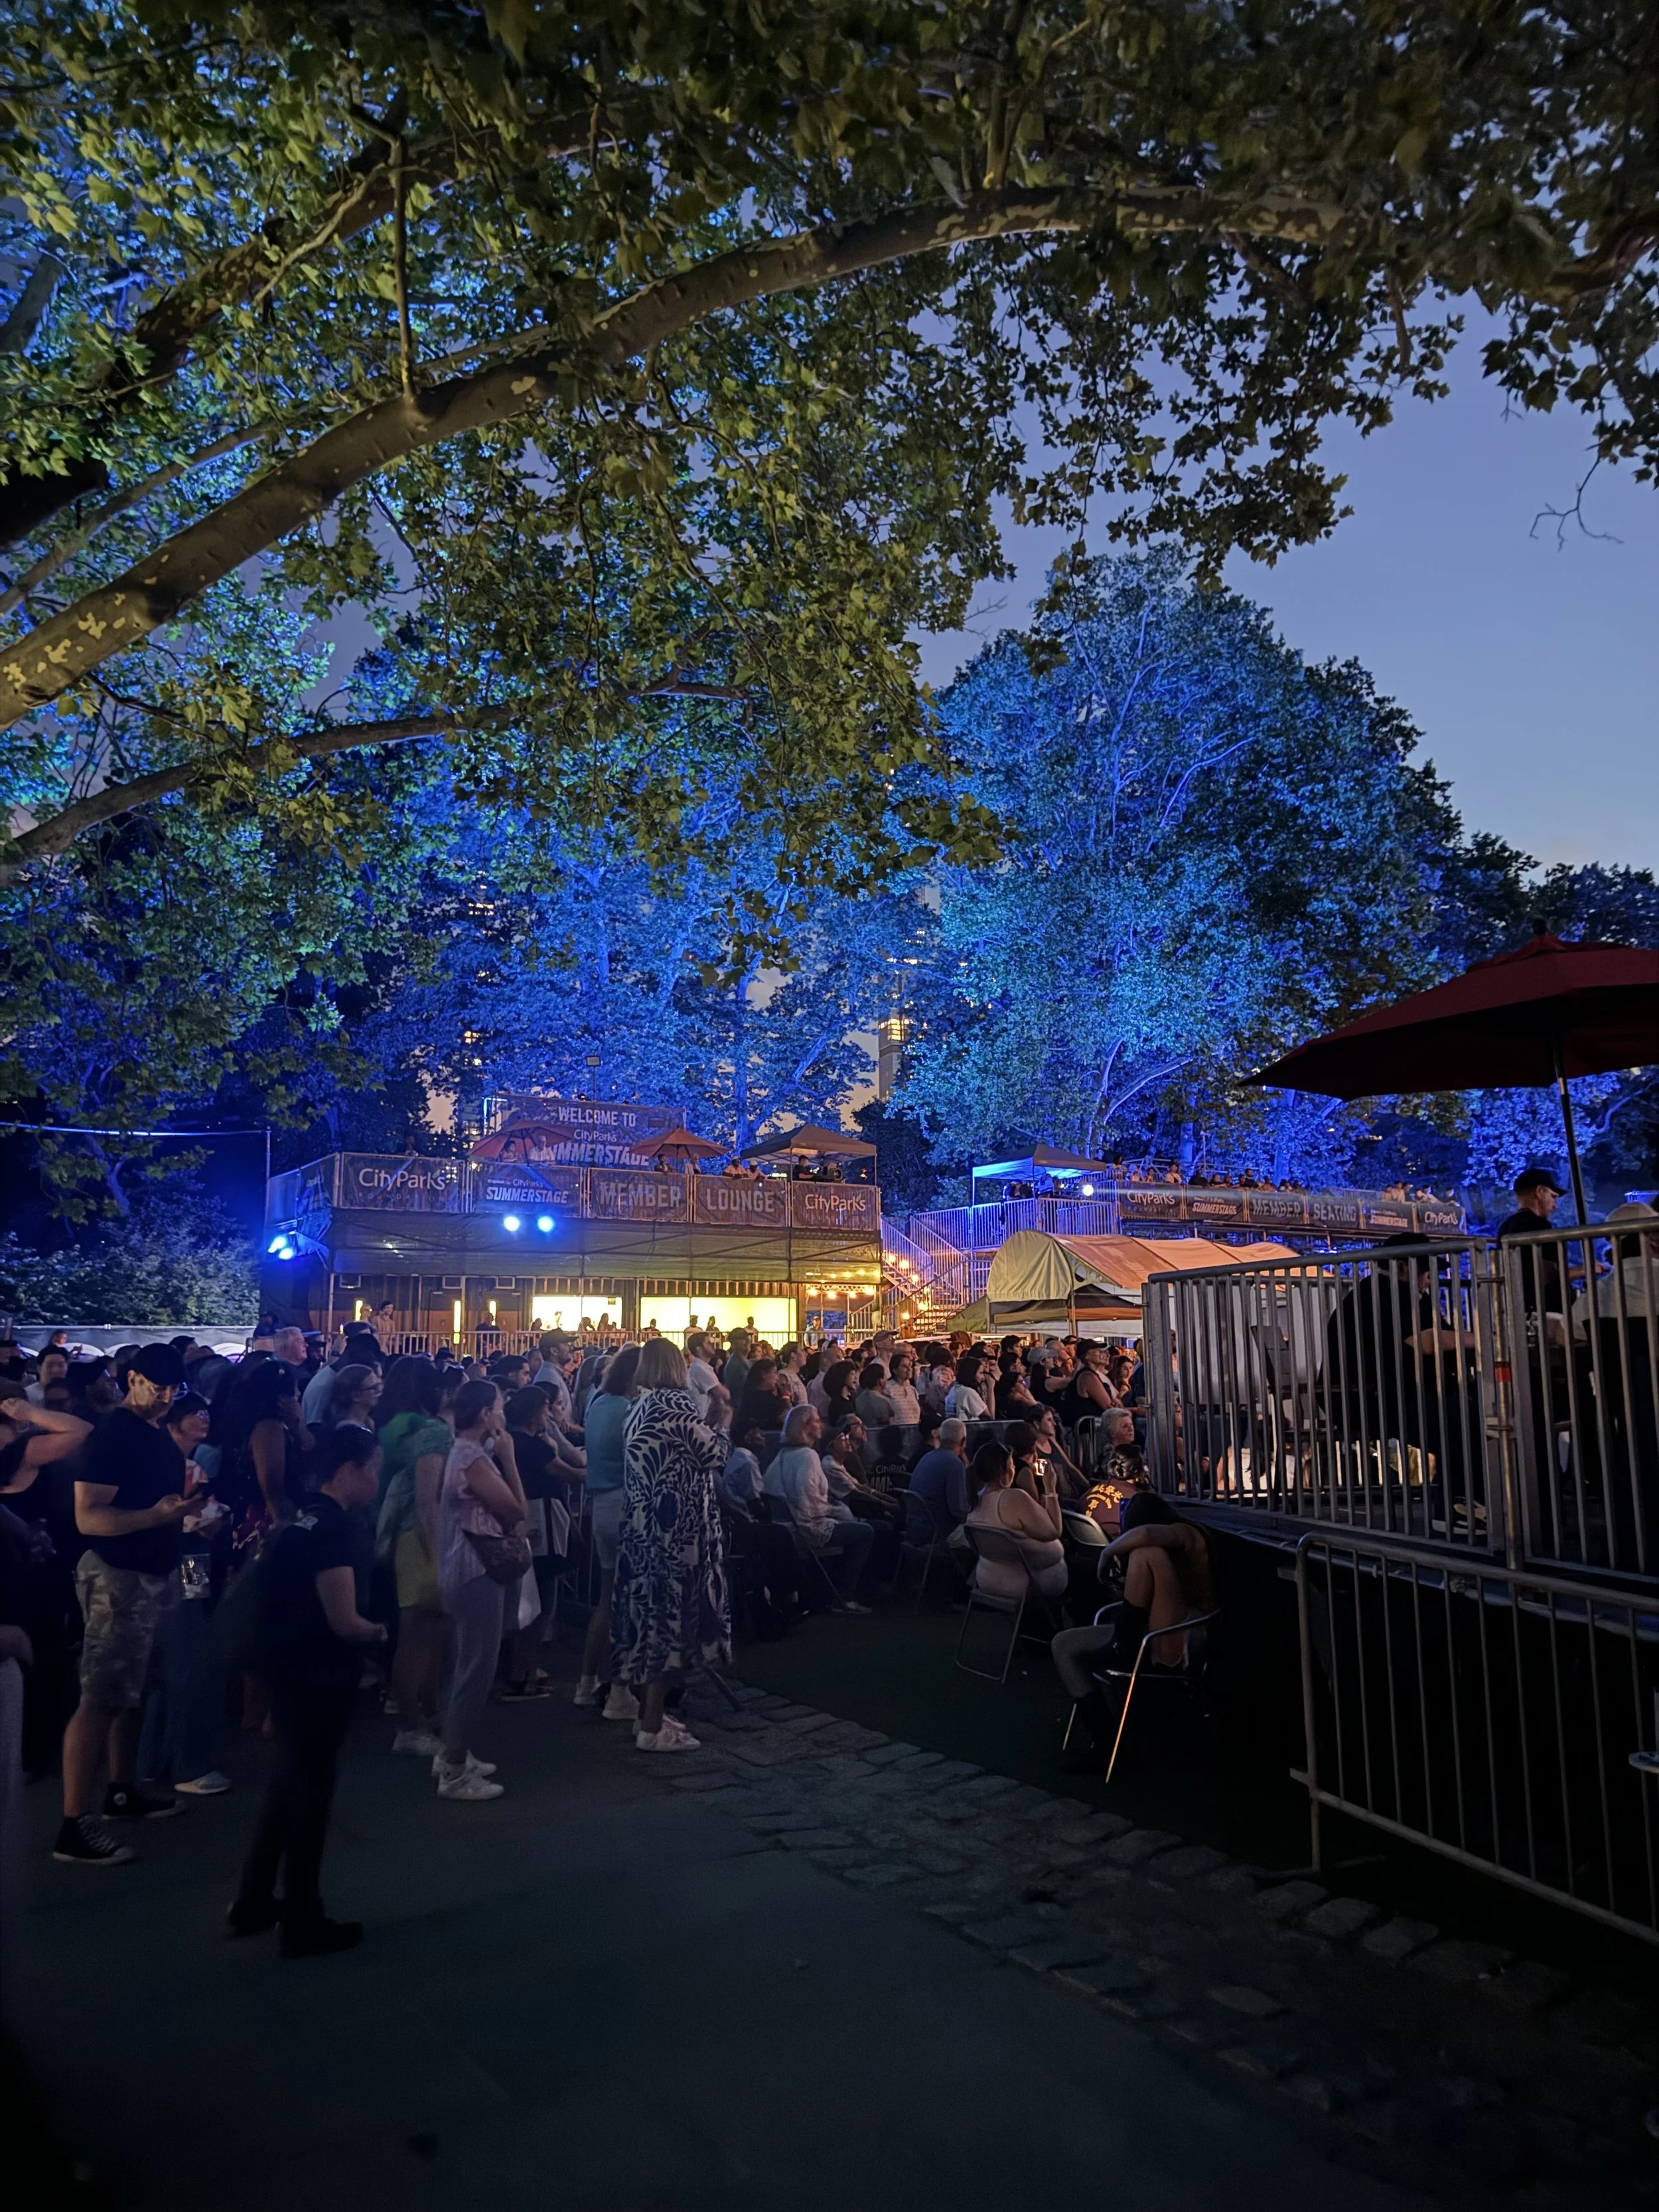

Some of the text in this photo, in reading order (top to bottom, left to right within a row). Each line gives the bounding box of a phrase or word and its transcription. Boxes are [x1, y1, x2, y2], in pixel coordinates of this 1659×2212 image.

[558, 1106, 636, 1127] WELCOME TO
[573, 1129, 617, 1142] CityParks
[359, 1167, 445, 1191] CityParks
[486, 1187, 569, 1204] SUMMERSTAGE
[600, 1183, 681, 1207] MEMBER
[707, 1189, 775, 1213] LOUNGE
[805, 1194, 866, 1213] CityParks
[1127, 1191, 1175, 1205] CityParks
[1192, 1202, 1237, 1215] SUMMERSTAGE
[1252, 1199, 1301, 1217] MEMBER
[1313, 1203, 1356, 1222] SEATING
[1424, 1211, 1458, 1224] CityParks
[876, 1464, 908, 1473] CityPark
